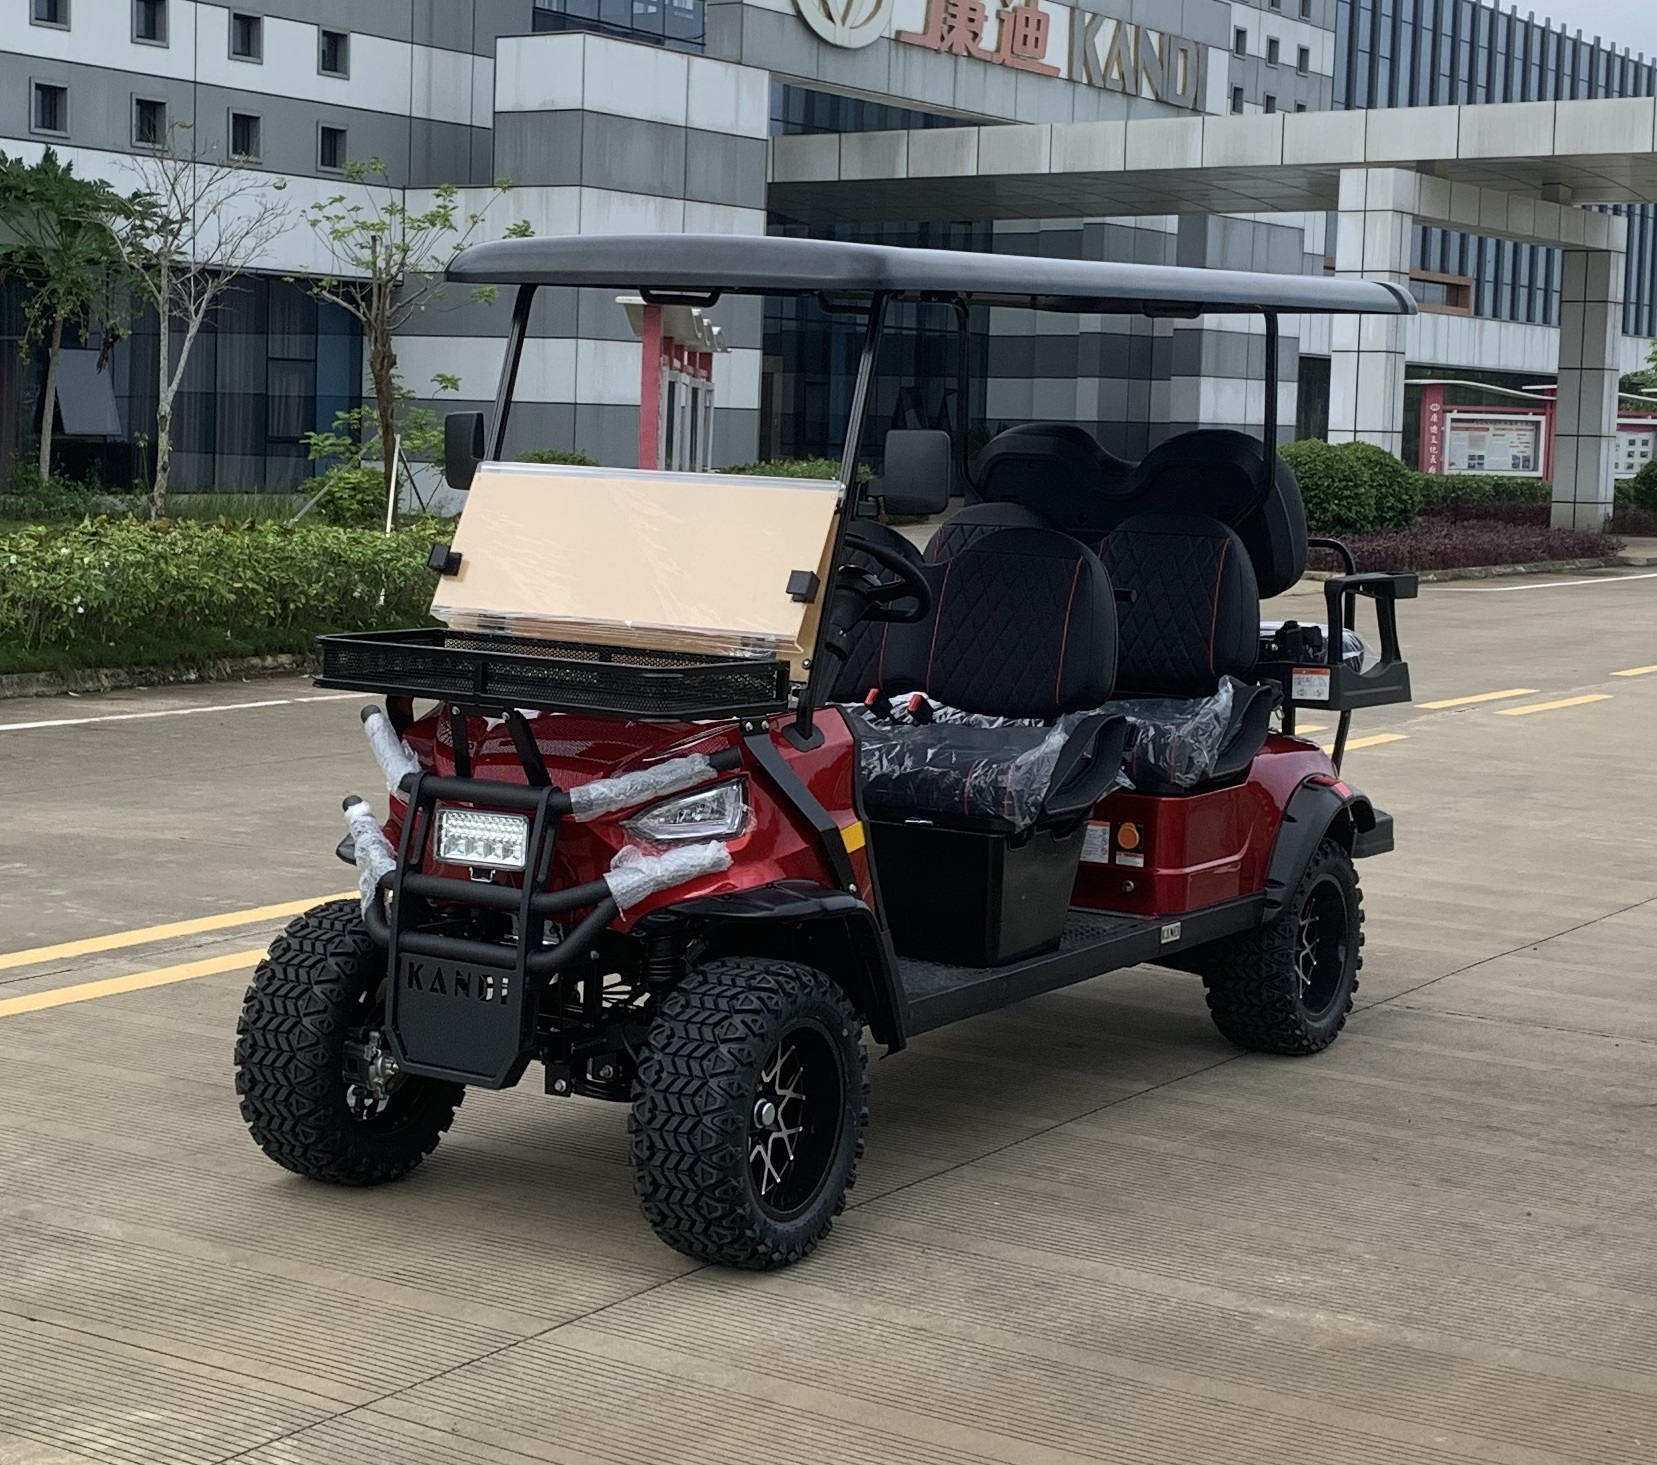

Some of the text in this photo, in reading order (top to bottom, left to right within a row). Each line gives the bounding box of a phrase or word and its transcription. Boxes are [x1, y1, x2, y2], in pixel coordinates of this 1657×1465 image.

[895, 0, 1209, 112] 康迪 KANDI
[407, 961, 509, 1005] KANDI
